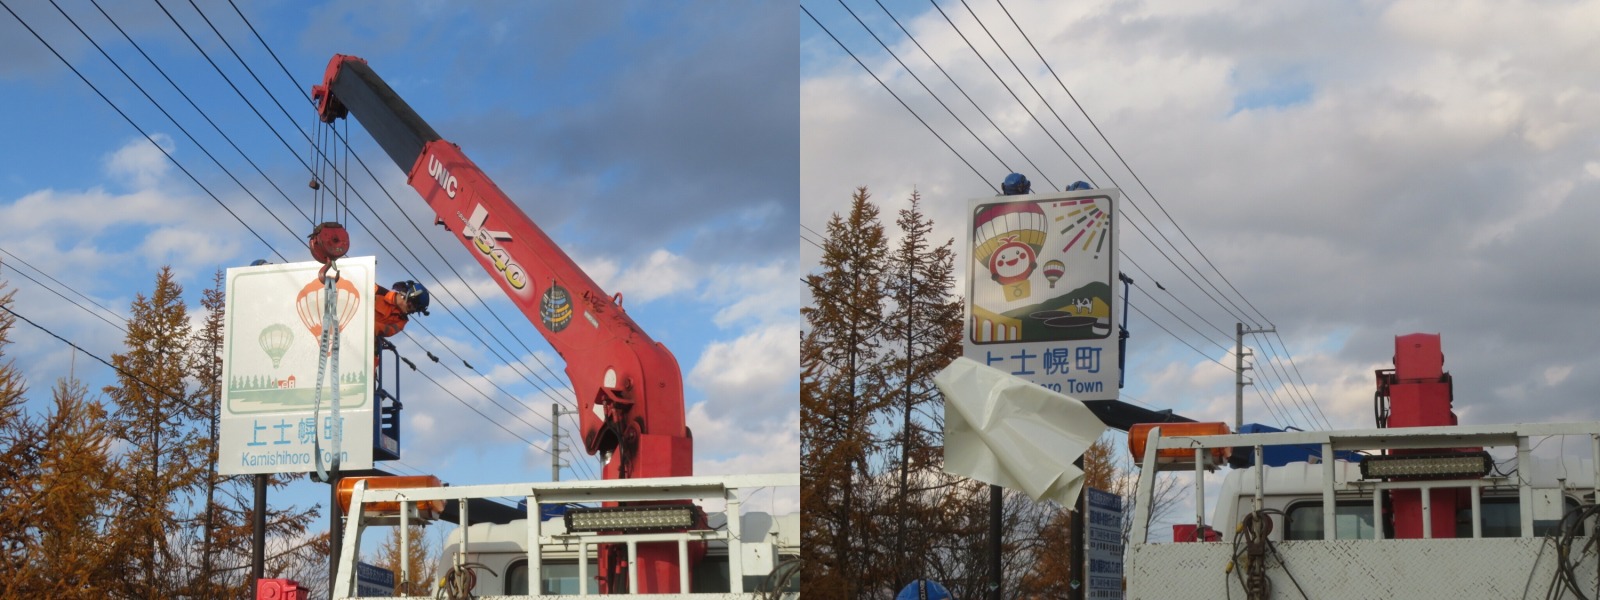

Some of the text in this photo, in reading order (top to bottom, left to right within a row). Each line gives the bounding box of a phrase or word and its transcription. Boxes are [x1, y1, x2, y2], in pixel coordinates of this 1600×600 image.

[428, 154, 458, 199] UNIC
[1067, 379, 1104, 393] Town
[241, 448, 348, 466] Kamishihoro on
